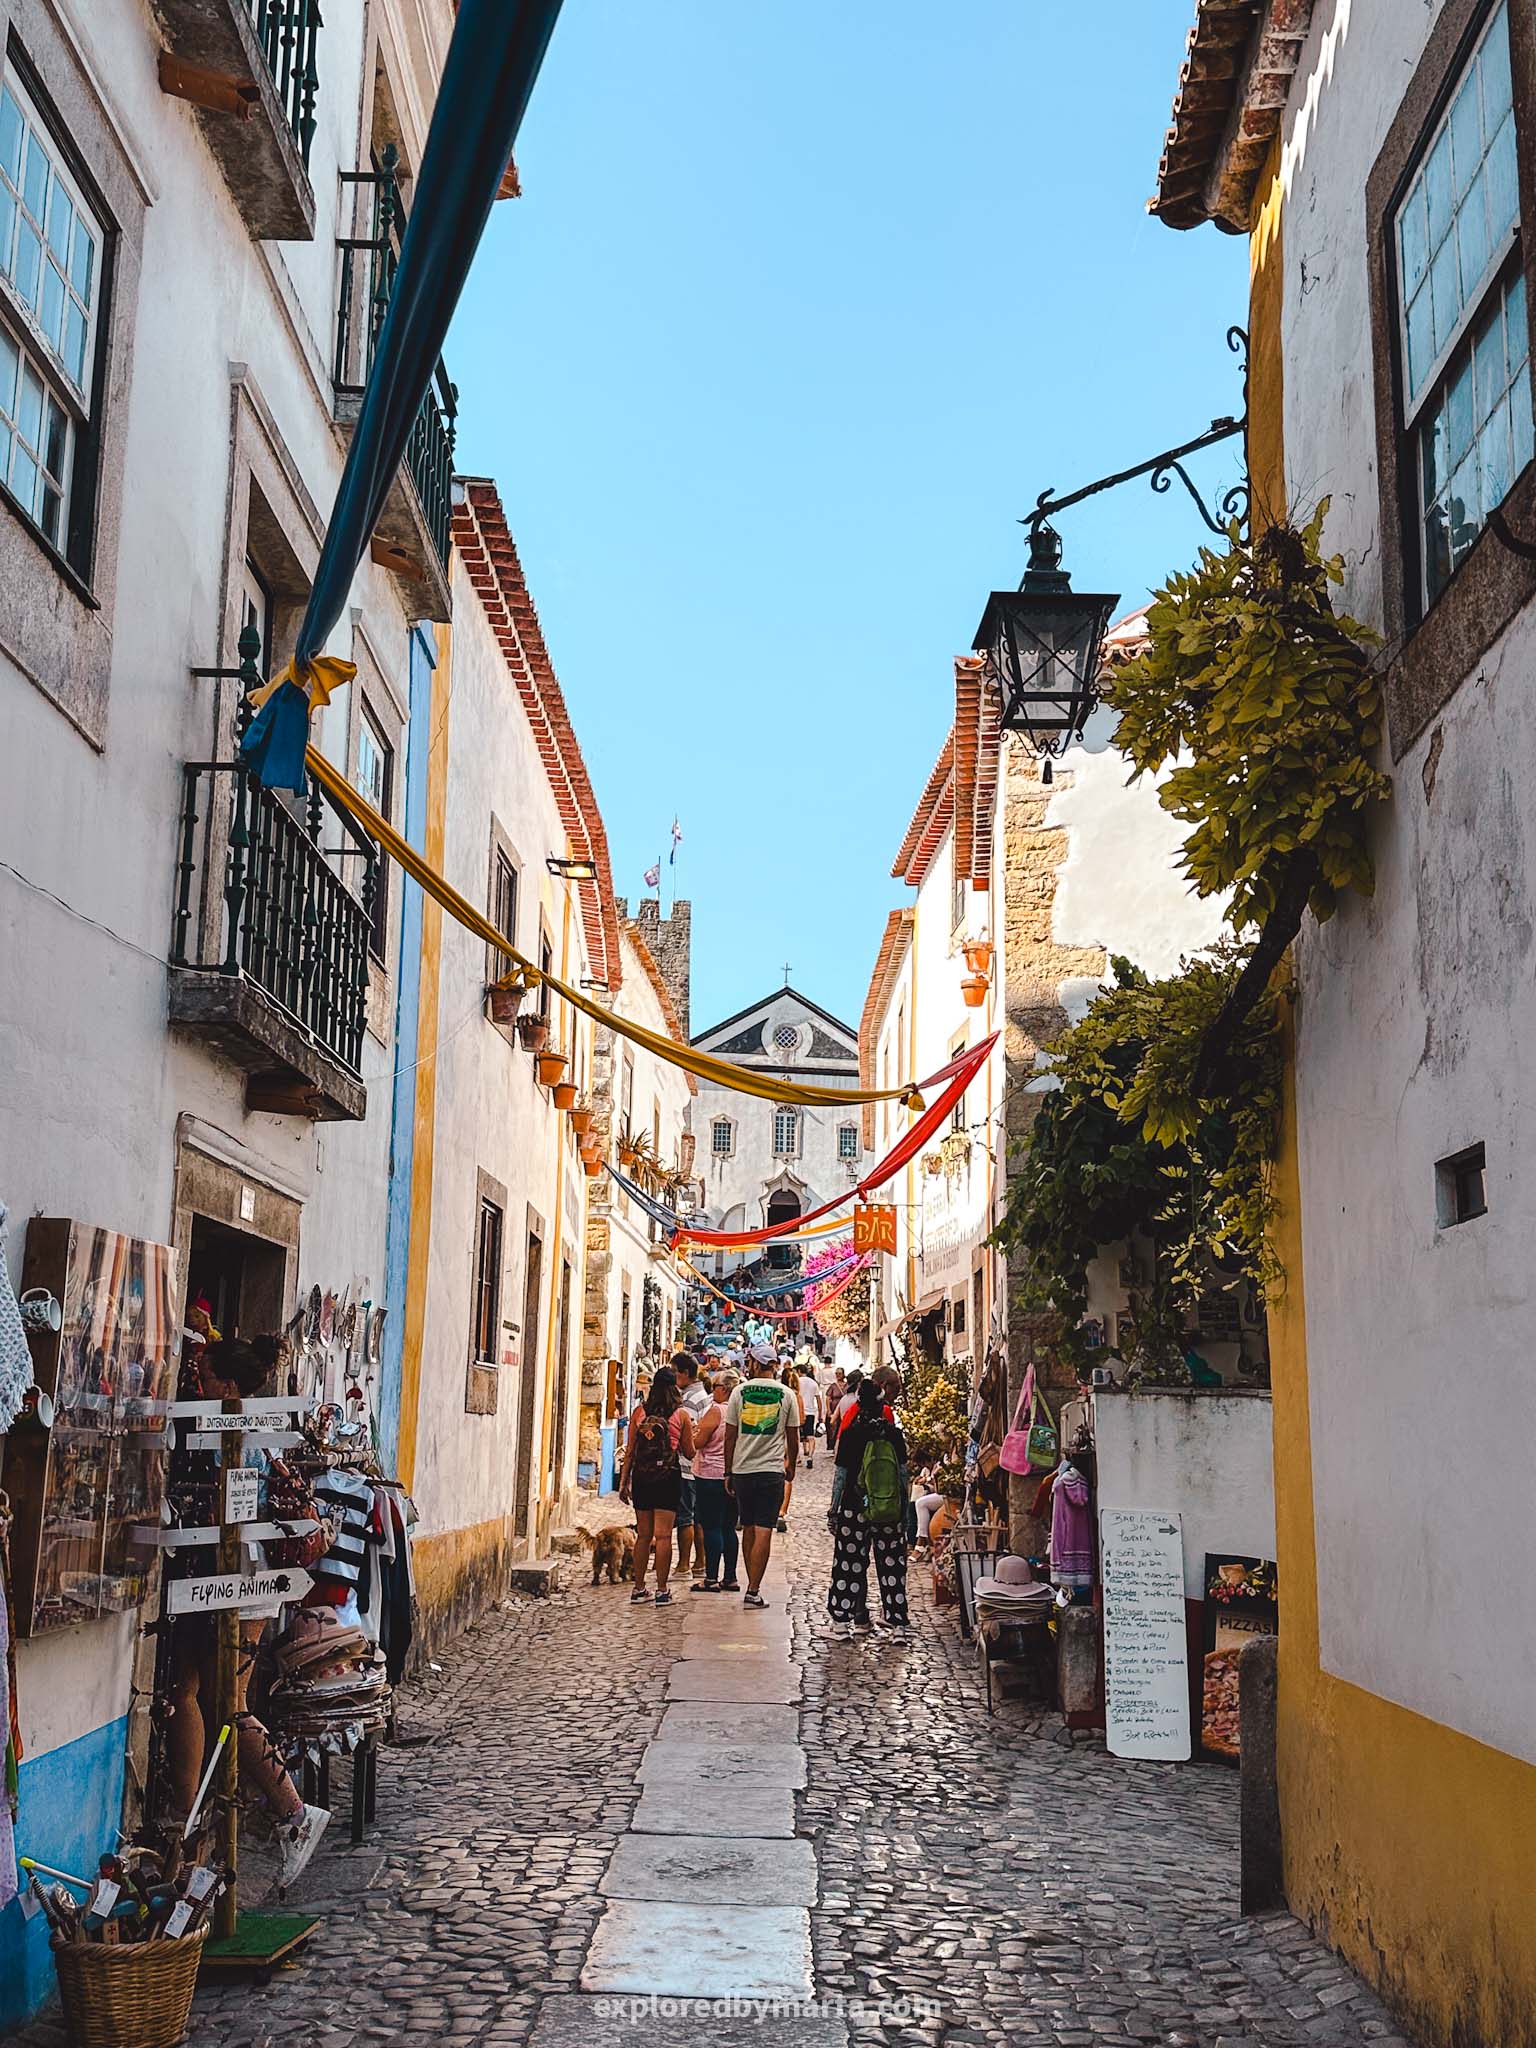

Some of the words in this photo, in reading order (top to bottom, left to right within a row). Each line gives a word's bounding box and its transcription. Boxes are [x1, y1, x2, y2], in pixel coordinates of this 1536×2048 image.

[855, 1216, 895, 1244] BAR
[191, 1582, 234, 1606] FLYING
[238, 1577, 292, 1600] ANIMAS
[1220, 1617, 1271, 1635] PIZZAS
